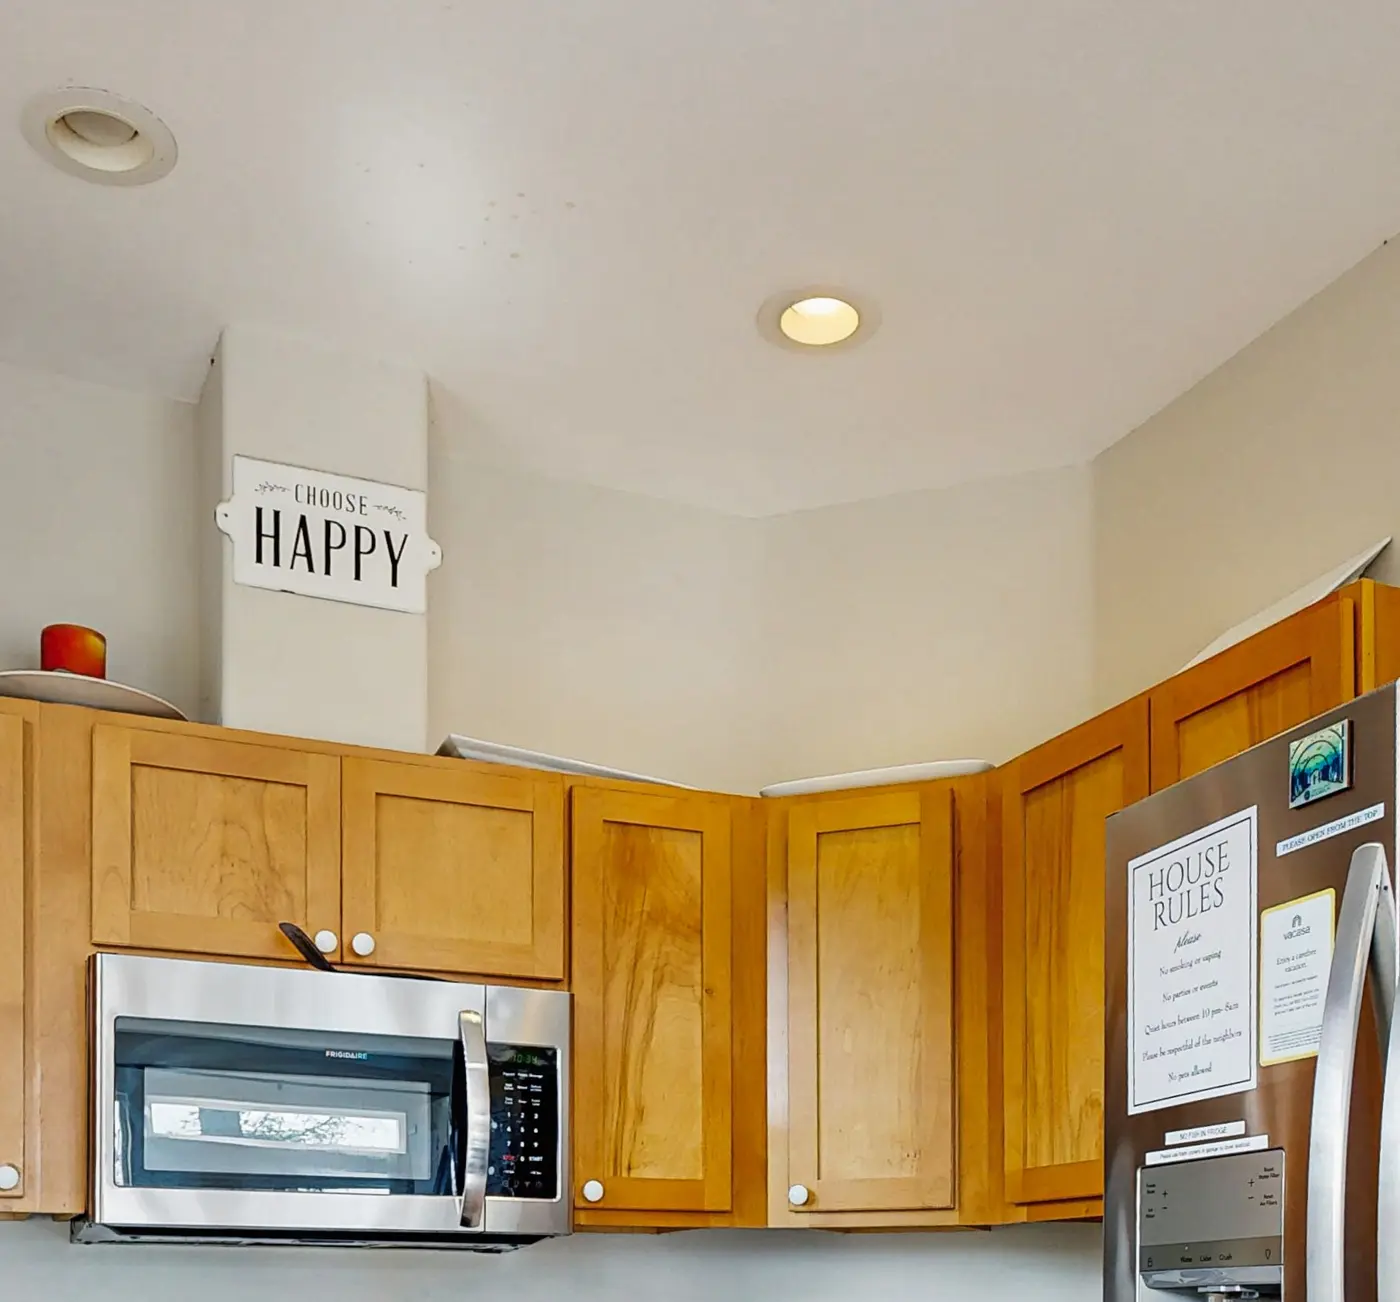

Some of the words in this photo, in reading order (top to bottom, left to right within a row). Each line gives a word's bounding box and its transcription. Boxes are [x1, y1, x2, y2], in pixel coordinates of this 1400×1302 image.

[294, 483, 369, 516] CHOOSE
[255, 506, 409, 588] HAPPY
[1281, 838, 1306, 852] PLEASE
[1307, 829, 1326, 842] OPEN
[1327, 821, 1347, 835] FROM
[1347, 815, 1362, 827] THE
[1363, 809, 1378, 821] TOP
[1148, 840, 1231, 901] HOUSE
[1153, 876, 1225, 931] RULES
[1173, 930, 1202, 954] please
[1283, 925, 1311, 941] vacasa
[1159, 966, 1169, 977] No
[1169, 958, 1193, 973] smoking
[1194, 957, 1201, 965] or
[1202, 950, 1222, 963] vaping
[1162, 992, 1172, 1003] No
[1172, 988, 1191, 1002] parties
[1199, 979, 1218, 991] events
[1144, 1024, 1160, 1036] Quiet
[1161, 1019, 1177, 1030] hours
[1177, 1013, 1200, 1025] between
[1201, 1008, 1210, 1019] 10
[325, 1050, 368, 1060] FRIGIDAIRE
[1142, 1050, 1158, 1062] Please
[1159, 1046, 1166, 1057] be
[1166, 1038, 1194, 1056] respectful
[1194, 1035, 1201, 1048] of
[1201, 1033, 1212, 1046] the
[1213, 1027, 1242, 1043] neighbors
[1168, 1071, 1177, 1082] No
[1177, 1070, 1190, 1082] pets
[1190, 1061, 1212, 1077] allowed
